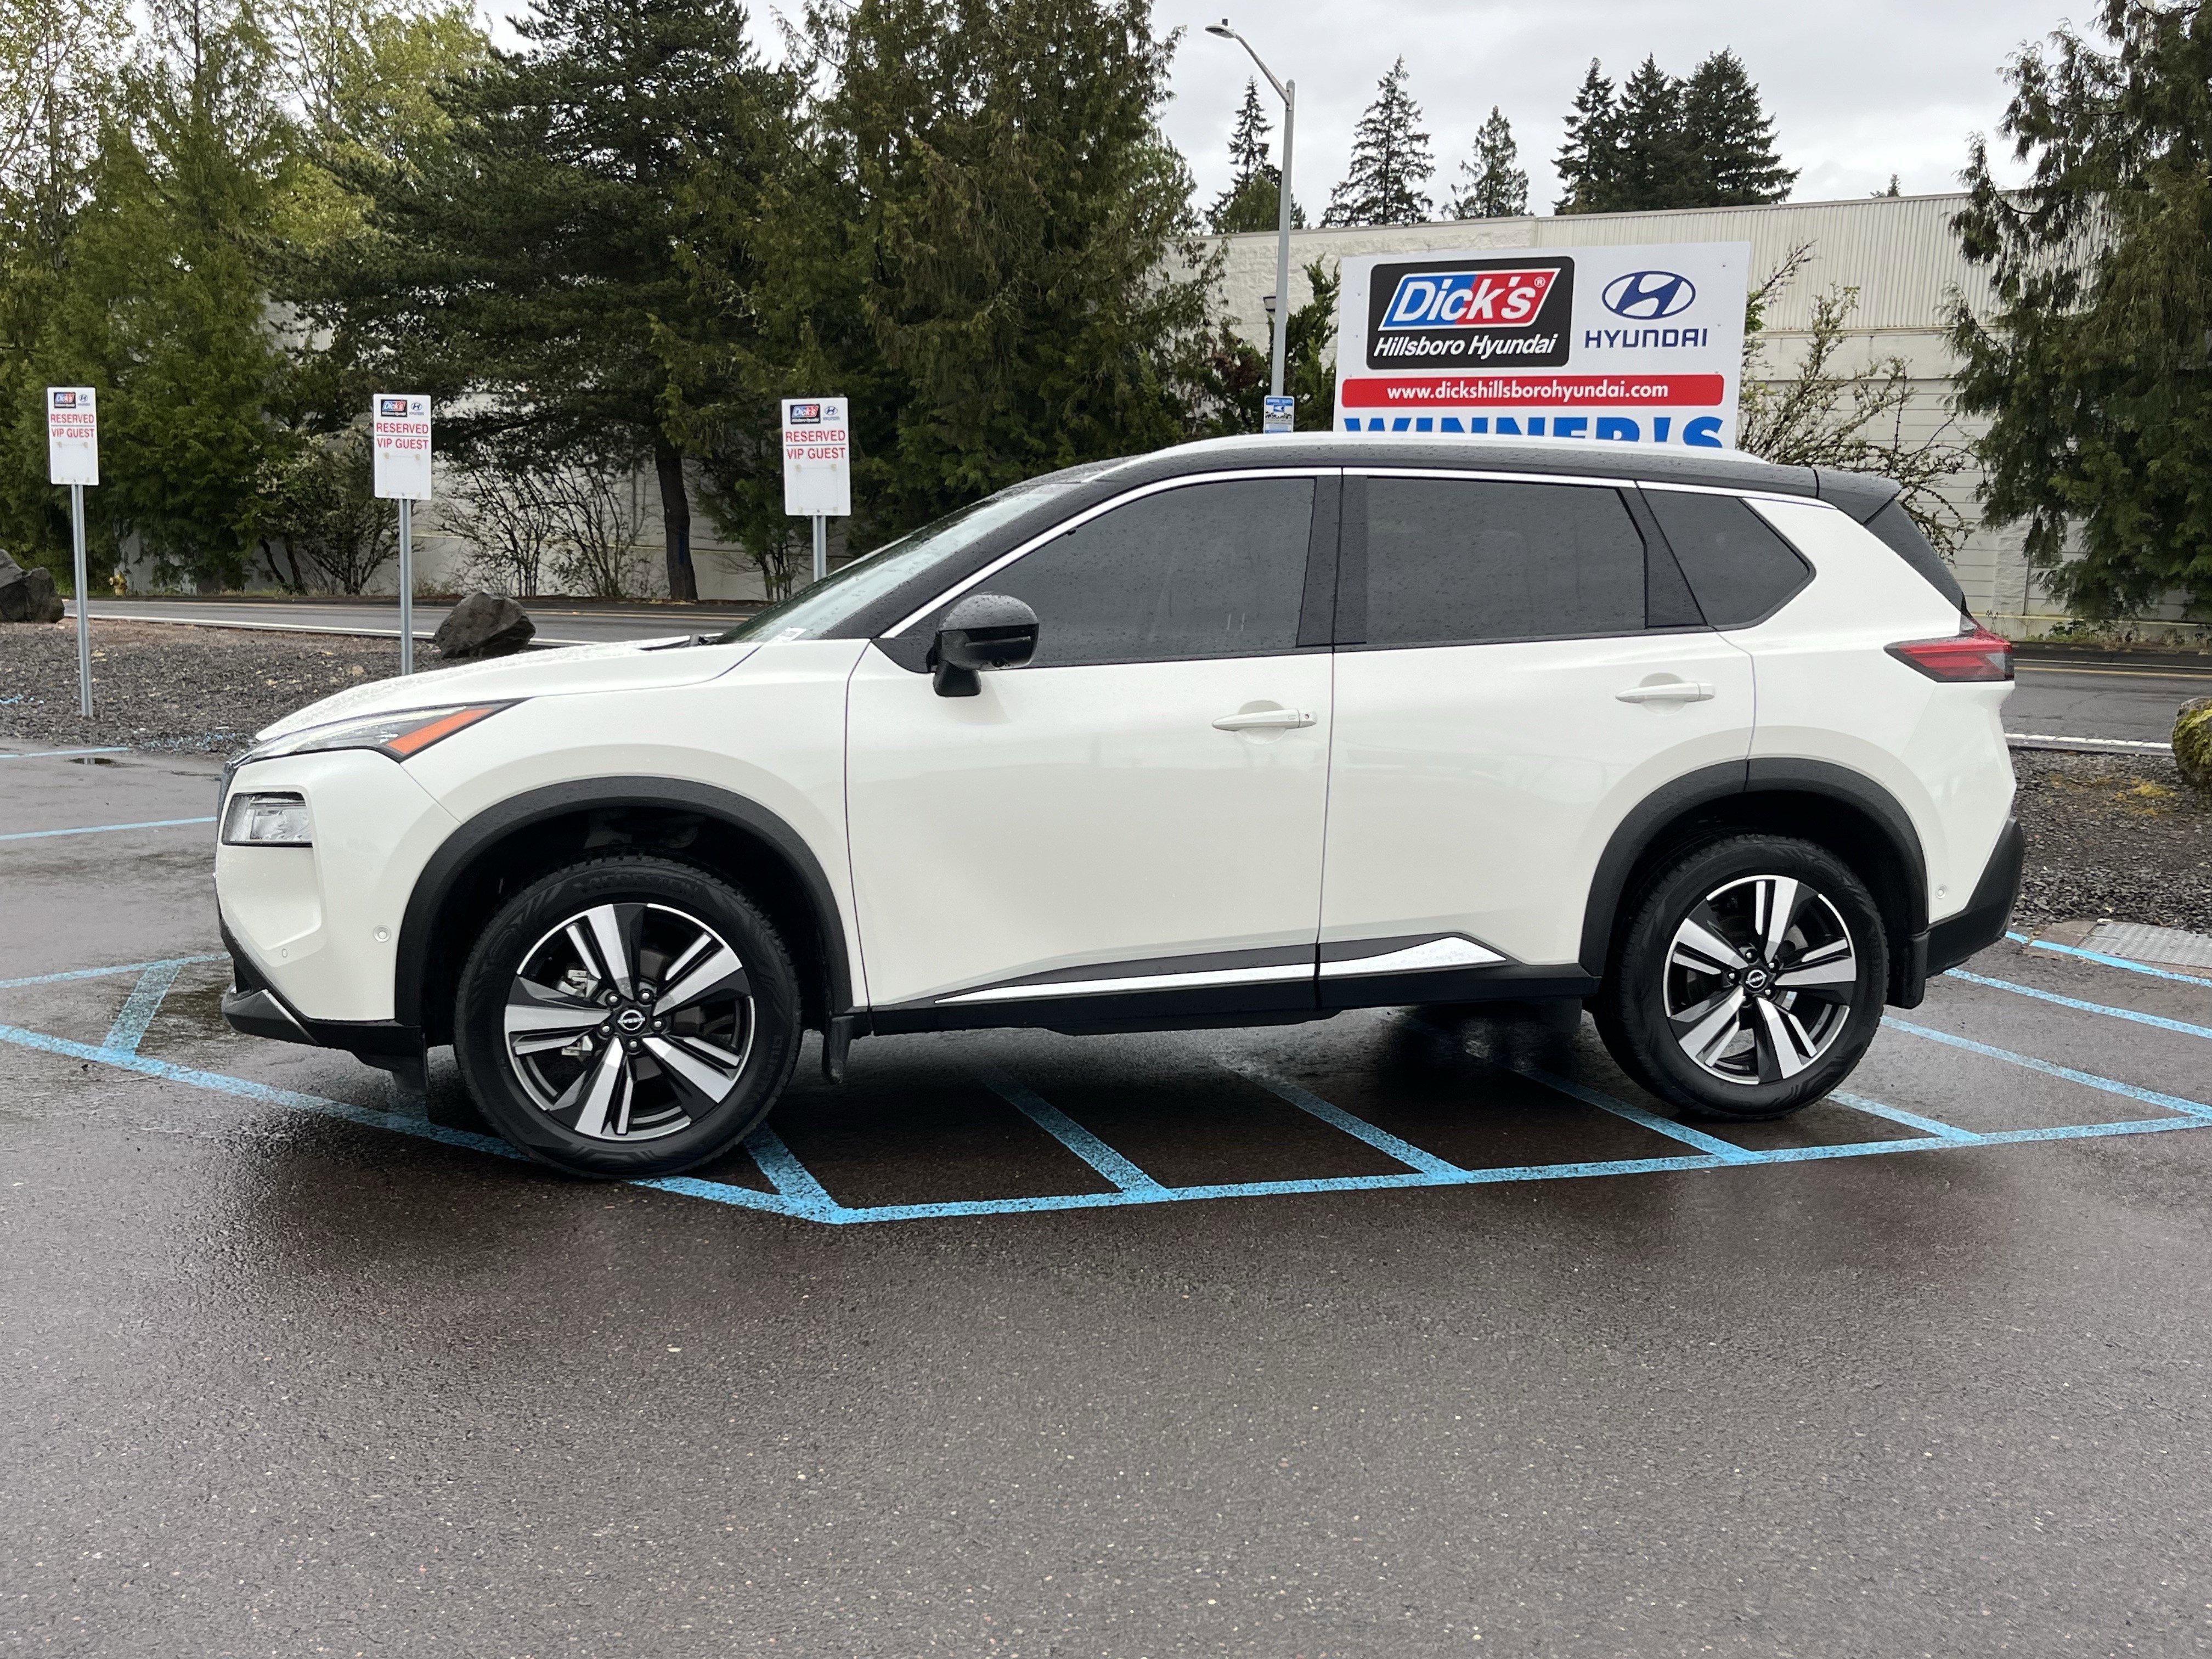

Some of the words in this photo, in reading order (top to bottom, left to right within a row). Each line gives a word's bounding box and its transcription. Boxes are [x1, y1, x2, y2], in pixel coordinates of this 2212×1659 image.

[1584, 328, 1707, 348] HYUNDAI
[1373, 336, 1465, 357] Hillsboro
[1468, 334, 1559, 360] Hyundai
[1386, 380, 1669, 403] www.dickshillsborohyundai.com
[50, 414, 94, 424] RESERVED
[52, 428, 64, 438] VIP
[67, 428, 94, 438] GUEST
[376, 422, 428, 434] RESERVED
[785, 430, 845, 442] RESERVED
[377, 439, 392, 448] VIP
[395, 439, 428, 449] GUEST
[787, 449, 804, 459] VIP
[808, 448, 845, 459] GUEST
